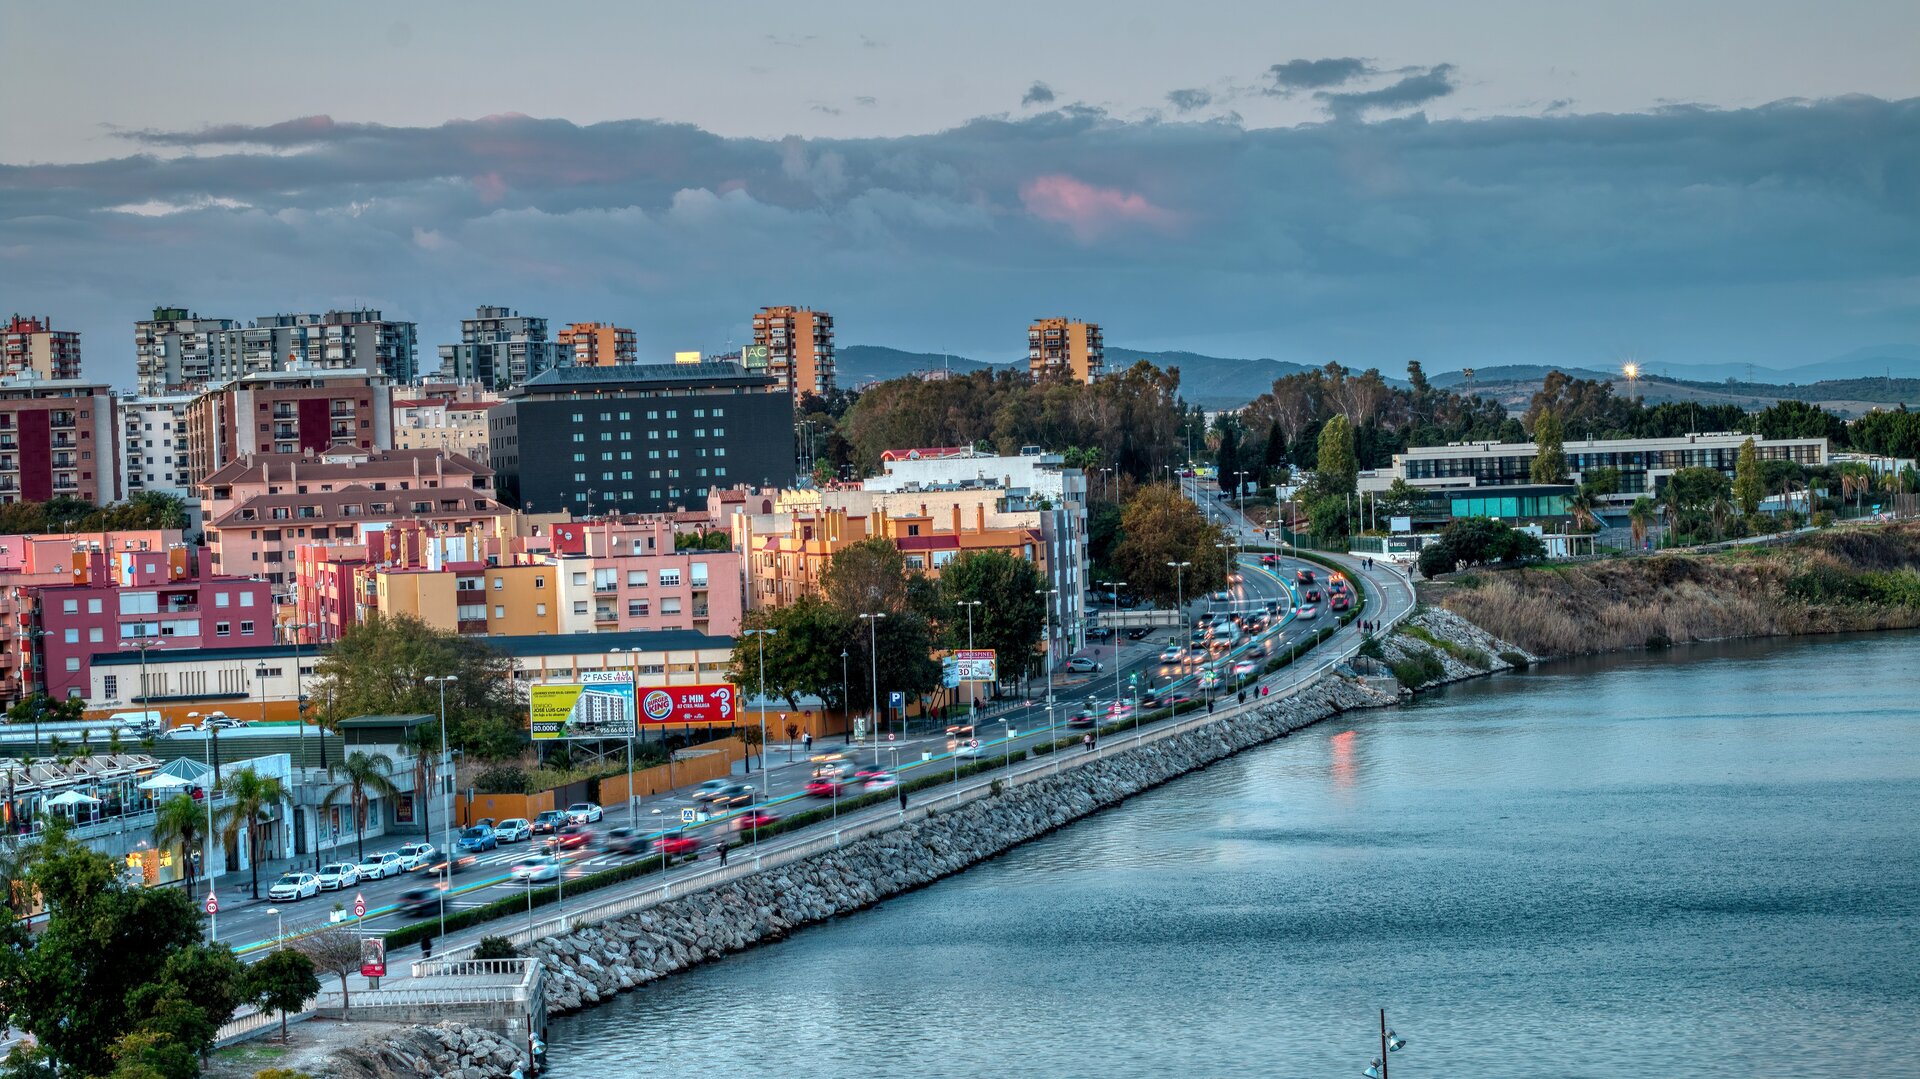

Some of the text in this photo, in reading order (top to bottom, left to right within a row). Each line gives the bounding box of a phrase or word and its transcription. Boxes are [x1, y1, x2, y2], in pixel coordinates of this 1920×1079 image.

[748, 347, 767, 357] AC
[958, 668, 970, 676] 3D
[593, 673, 612, 681] FASE
[647, 696, 668, 706] BURGER
[681, 694, 704, 703] 5 MIN
[892, 693, 900, 702] P
[648, 700, 670, 713] KING
